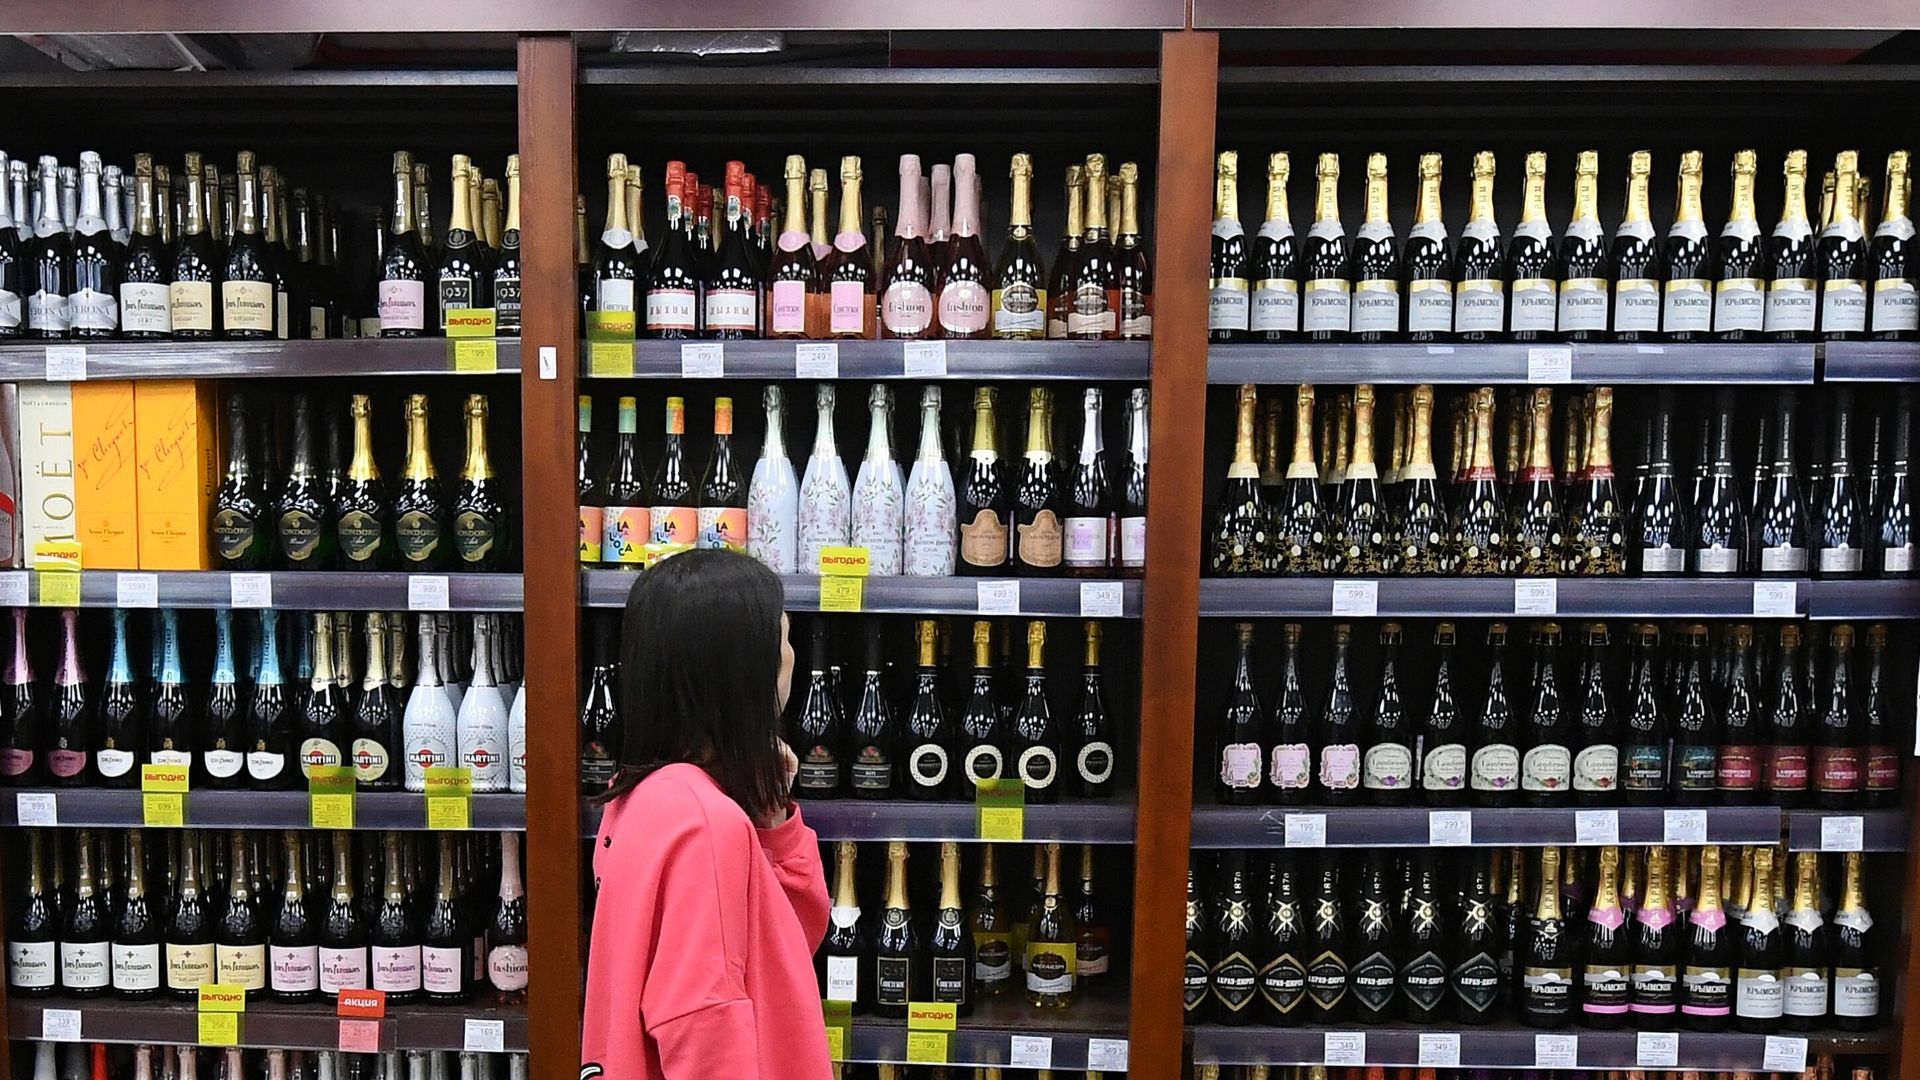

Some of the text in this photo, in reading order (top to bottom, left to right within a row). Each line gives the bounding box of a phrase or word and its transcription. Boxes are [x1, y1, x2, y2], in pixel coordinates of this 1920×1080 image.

[442, 287, 468, 299] 1937
[497, 287, 521, 299] 1937
[888, 301, 925, 313] fashion
[946, 300, 984, 313] fashion
[449, 318, 492, 326] ВЫГОДНО
[617, 521, 629, 533] LA
[664, 521, 677, 533] LA
[716, 521, 728, 533] LA
[822, 557, 866, 565] ВЫГОДНО
[1096, 591, 1110, 600] 349
[1349, 590, 1363, 599] 599
[1530, 588, 1544, 597] 599
[302, 754, 335, 765] MARTINI
[409, 752, 445, 763] MARTINI
[464, 753, 499, 763] MARTINI
[144, 772, 186, 783] ВЫГОДНО
[427, 777, 470, 786] ВЫГОДНО
[1299, 822, 1314, 831] 199
[1444, 821, 1458, 829] 299
[1591, 820, 1605, 828] 299
[1679, 819, 1694, 828] 299
[1234, 871, 1242, 894] 1870
[1282, 872, 1290, 895] 1870
[1323, 871, 1332, 894] 1870
[1422, 871, 1431, 894] 1870
[1606, 872, 1615, 904] КРЫМ
[1651, 872, 1660, 904] КРЫМ
[1706, 874, 1715, 905] КРЫМ
[1544, 879, 1554, 910] КРЫМ
[493, 961, 528, 973] fashion
[1531, 984, 1568, 994] КРЫМСКОЕ
[1592, 982, 1627, 992] КРЫМСКОЕ
[1635, 981, 1672, 991] КРЫМСКОЕ
[1690, 984, 1727, 993] КРЫМСКОЕ
[201, 993, 242, 1002] ВЫГОДНО
[344, 998, 378, 1008] АКЦИЯ
[911, 1011, 954, 1020] ВЫГОДНО
[1339, 1041, 1354, 1050] 349
[1434, 1043, 1448, 1051] 349
